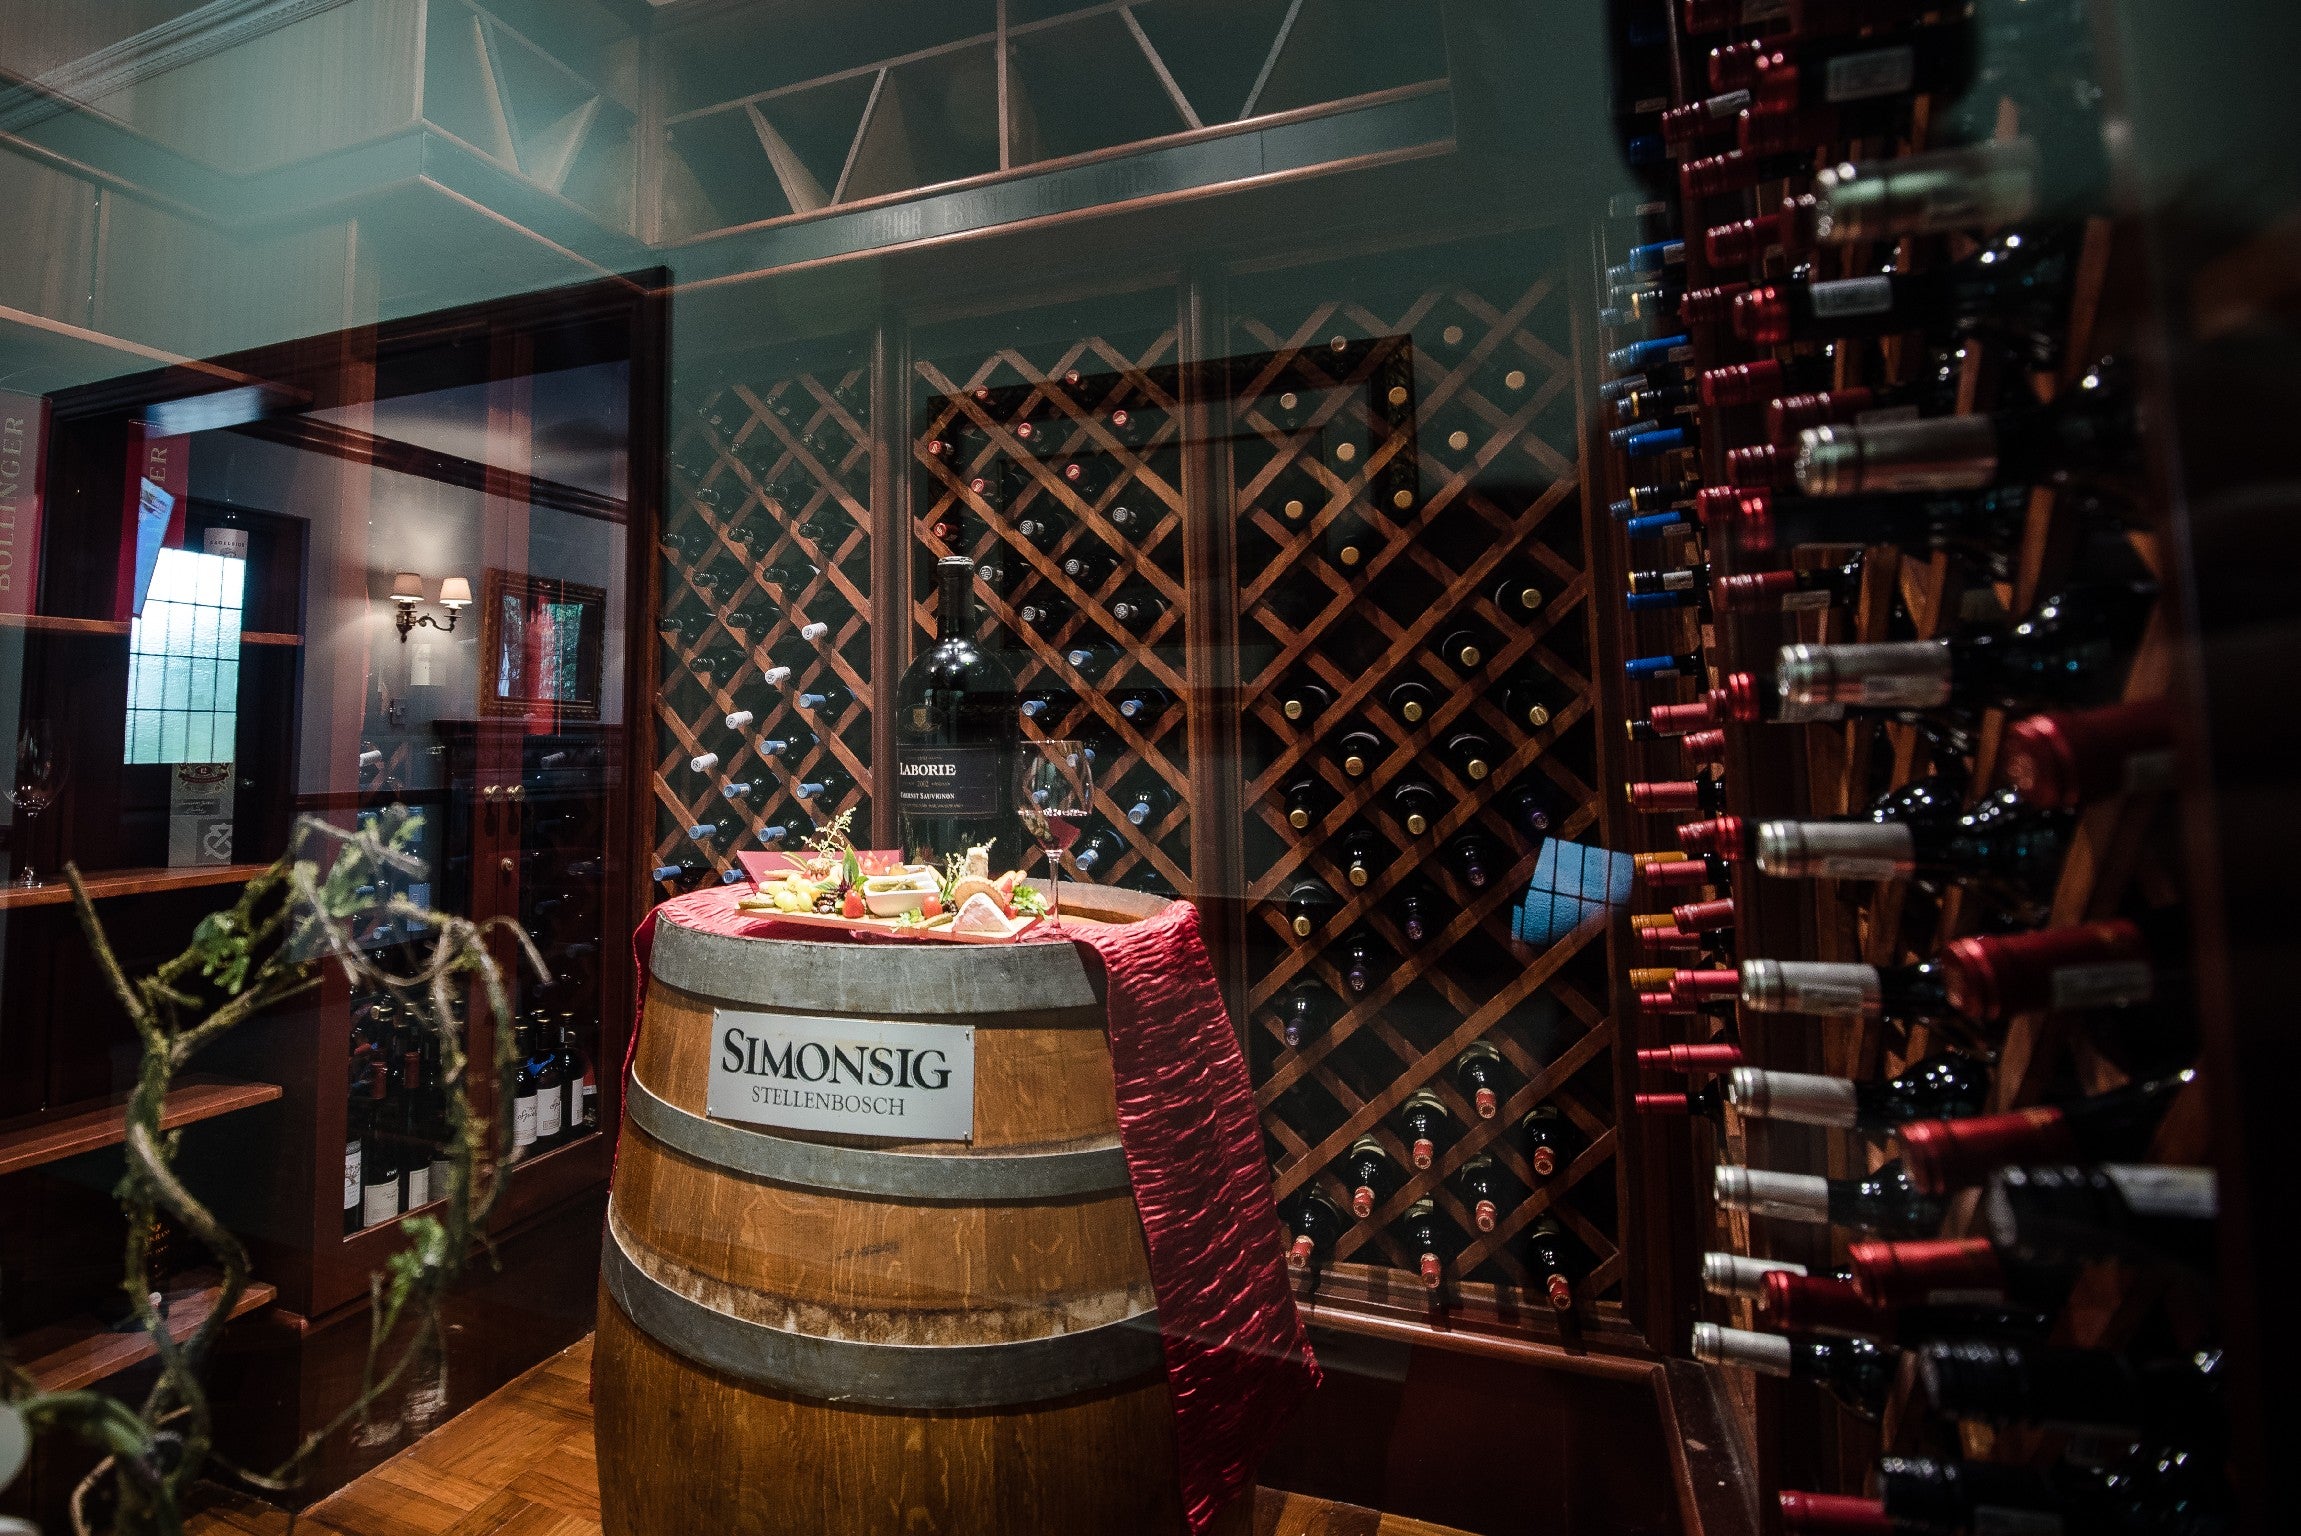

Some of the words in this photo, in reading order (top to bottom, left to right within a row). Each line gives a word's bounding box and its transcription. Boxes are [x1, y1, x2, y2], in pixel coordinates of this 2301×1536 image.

[900, 762, 956, 776] LABORIE
[722, 1028, 952, 1090] SIMONSIG
[752, 1086, 905, 1116] STELLENBOSCH
